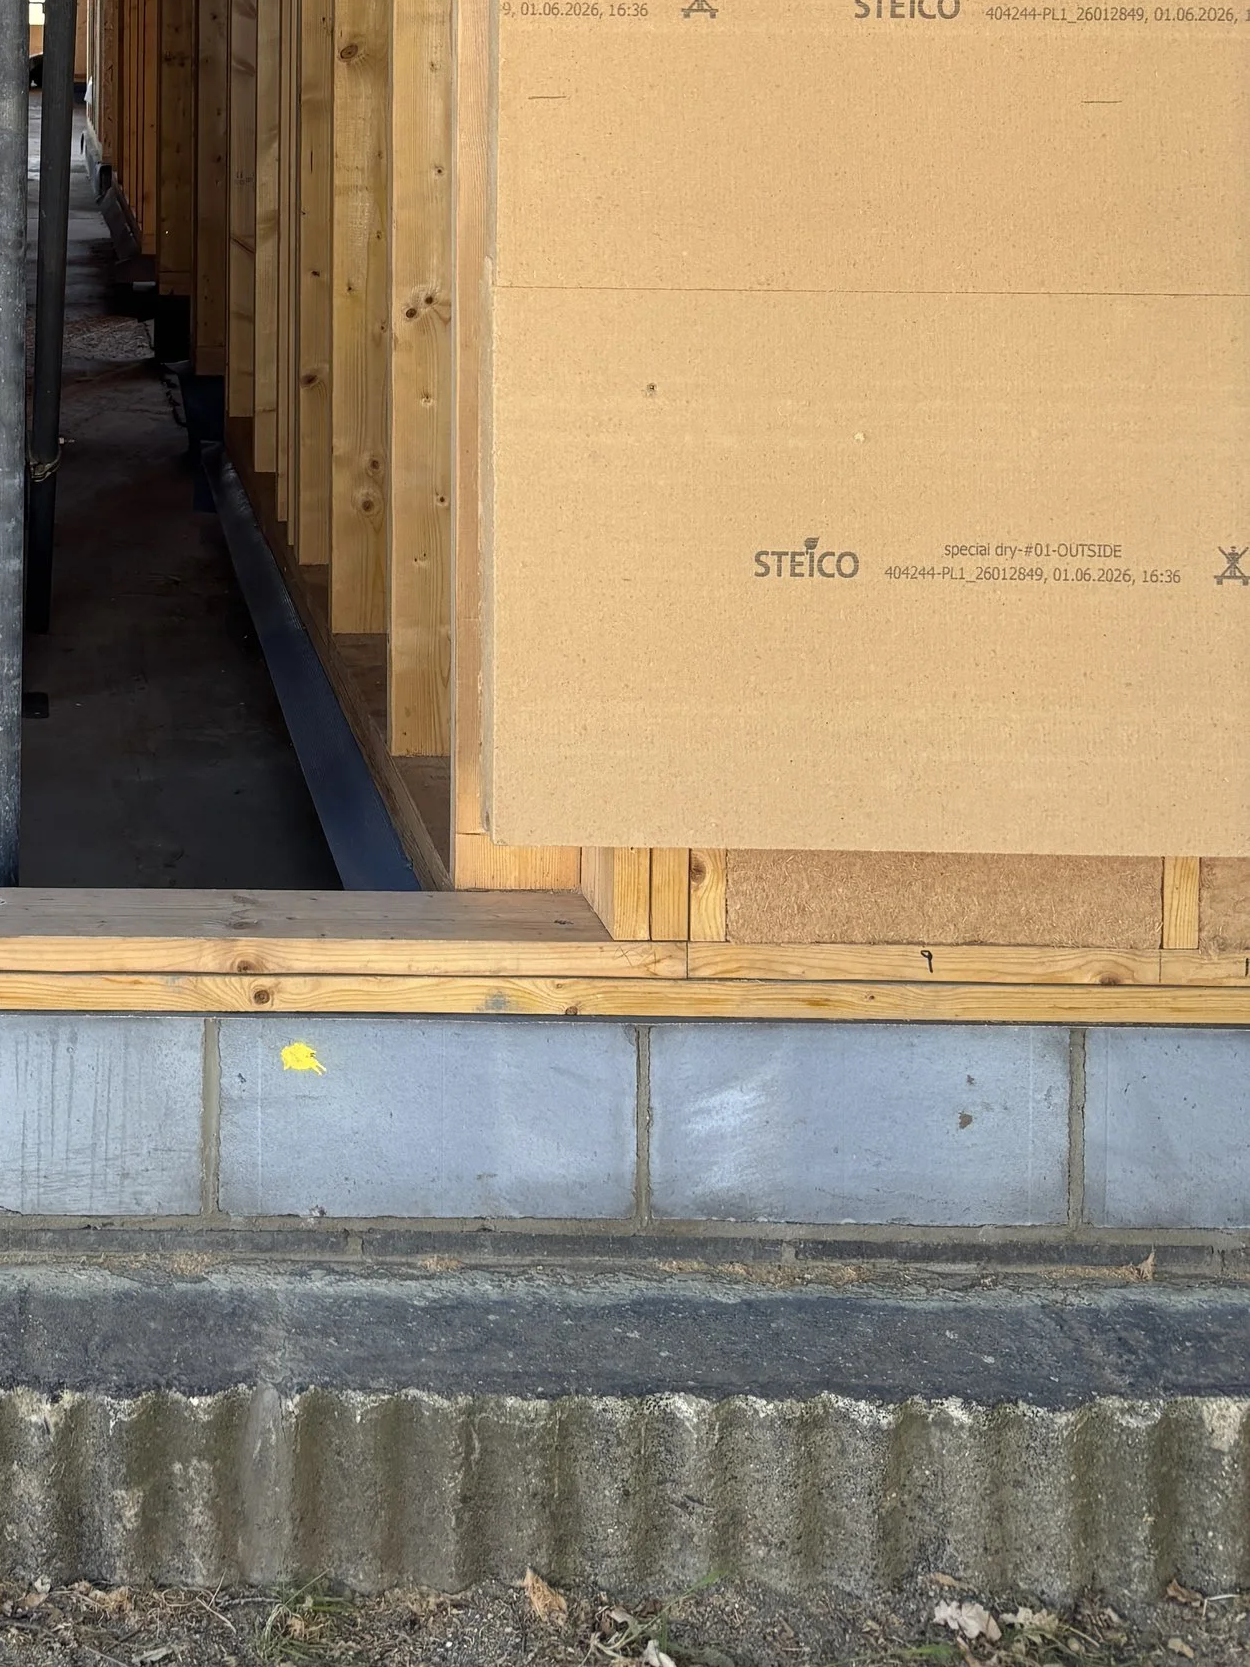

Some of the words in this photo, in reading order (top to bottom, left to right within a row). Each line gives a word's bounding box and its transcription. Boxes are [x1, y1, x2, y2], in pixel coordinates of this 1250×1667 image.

[520, 1, 603, 19] 01.06.2026,
[609, 2, 649, 17] 16:36
[985, 6, 1149, 24] 404244-PL1_26012849,
[1153, 6, 1238, 24] 01.06.2026,
[754, 536, 860, 579] STEICO
[944, 542, 990, 559] special
[995, 542, 1122, 560] dry-#01-OUTSIDE
[884, 565, 1048, 584] 404244-PL1_26012849,
[1052, 567, 1136, 586] 01.06.2026,
[1142, 569, 1181, 584] 16:36
